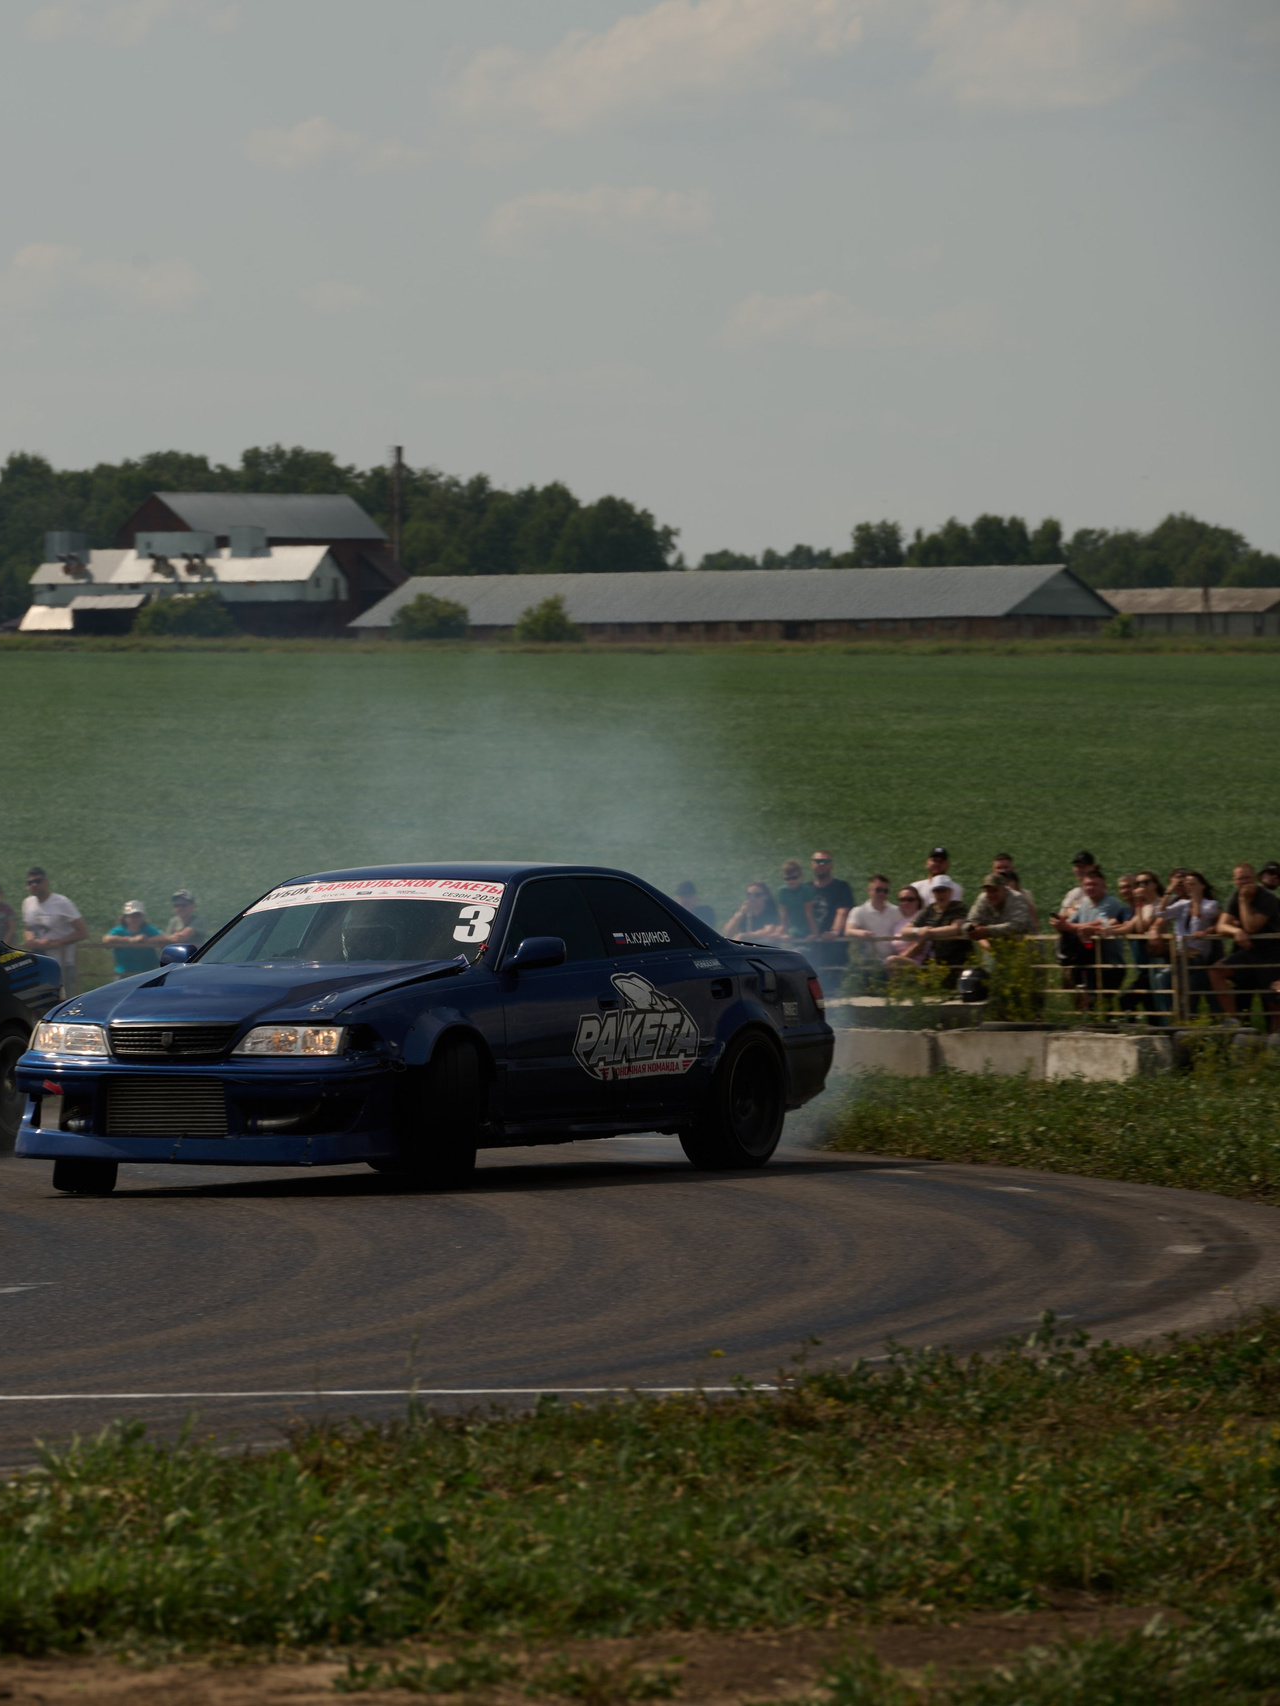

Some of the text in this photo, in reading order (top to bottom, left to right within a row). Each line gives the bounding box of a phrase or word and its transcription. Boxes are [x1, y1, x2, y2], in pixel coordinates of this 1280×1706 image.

[262, 886, 314, 902] КУБОК
[439, 880, 505, 895] РАКЕТЫ
[442, 891, 500, 903] СЕЗОН 2025
[453, 905, 495, 943] 3
[625, 931, 671, 946] А.КУДИНОВ
[577, 1011, 696, 1066] РАКЕТА
[647, 1061, 680, 1073] КОМАНДА
